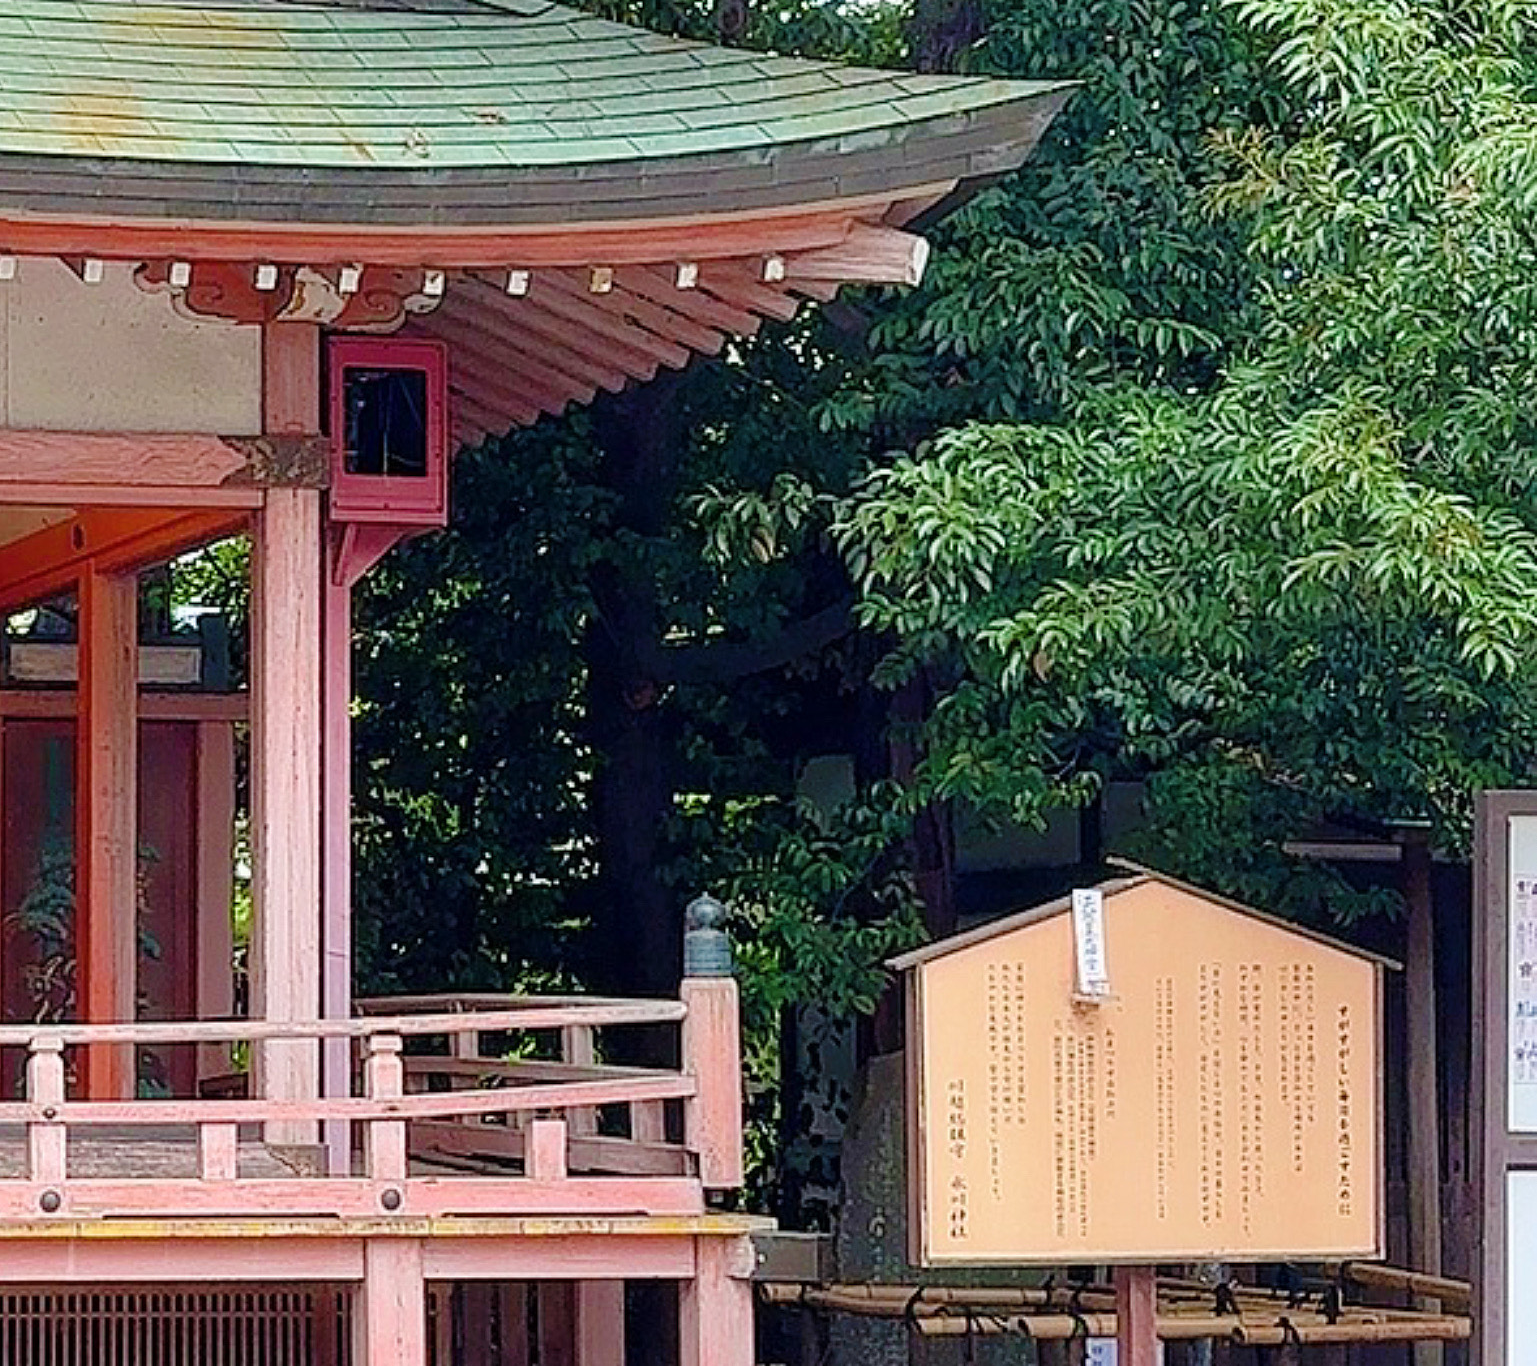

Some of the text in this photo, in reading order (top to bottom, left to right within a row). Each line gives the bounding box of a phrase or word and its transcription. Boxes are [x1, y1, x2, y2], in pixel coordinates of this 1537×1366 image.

[1337, 1003, 1353, 1218] すがすがしい毎日を過ごすために
[950, 1175, 969, 1240] 氷川神社
